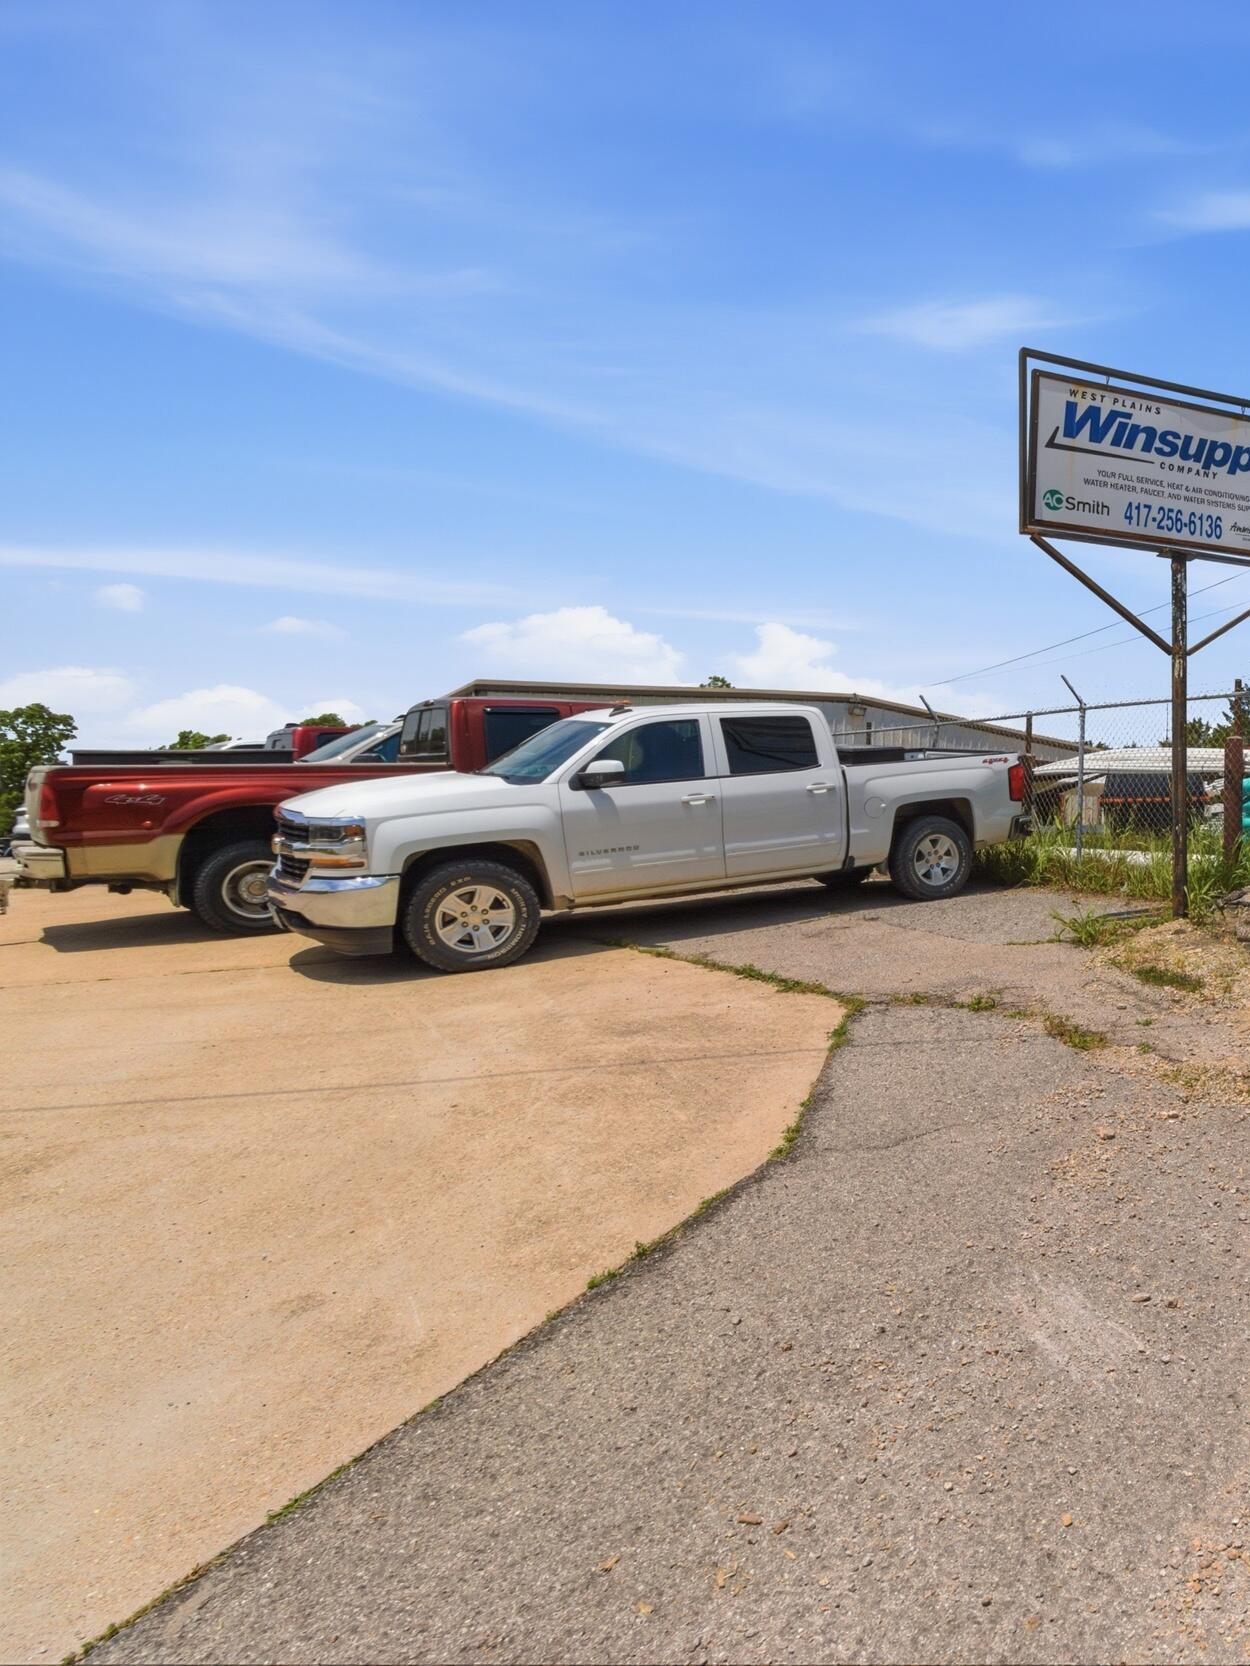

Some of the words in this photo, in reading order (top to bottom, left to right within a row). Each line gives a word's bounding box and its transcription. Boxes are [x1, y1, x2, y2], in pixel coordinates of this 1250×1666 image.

[1069, 388, 1106, 404] WEST
[1113, 398, 1161, 415] PLAINS
[1159, 461, 1218, 480] COMPANY
[1083, 478, 1109, 489] WATER
[1110, 481, 1138, 495] HEATER,
[1167, 491, 1182, 501] AND
[1183, 495, 1206, 505] WATER
[1206, 498, 1236, 511] SYSTEMS
[1097, 469, 1116, 480] YOUR
[1118, 473, 1135, 483] FULL
[1167, 482, 1183, 491] HEAT
[1192, 487, 1203, 495] AIR
[1204, 489, 1250, 503] CONDITIONING
[1065, 496, 1110, 517] Smith
[1124, 501, 1223, 540] 417-256-6136
